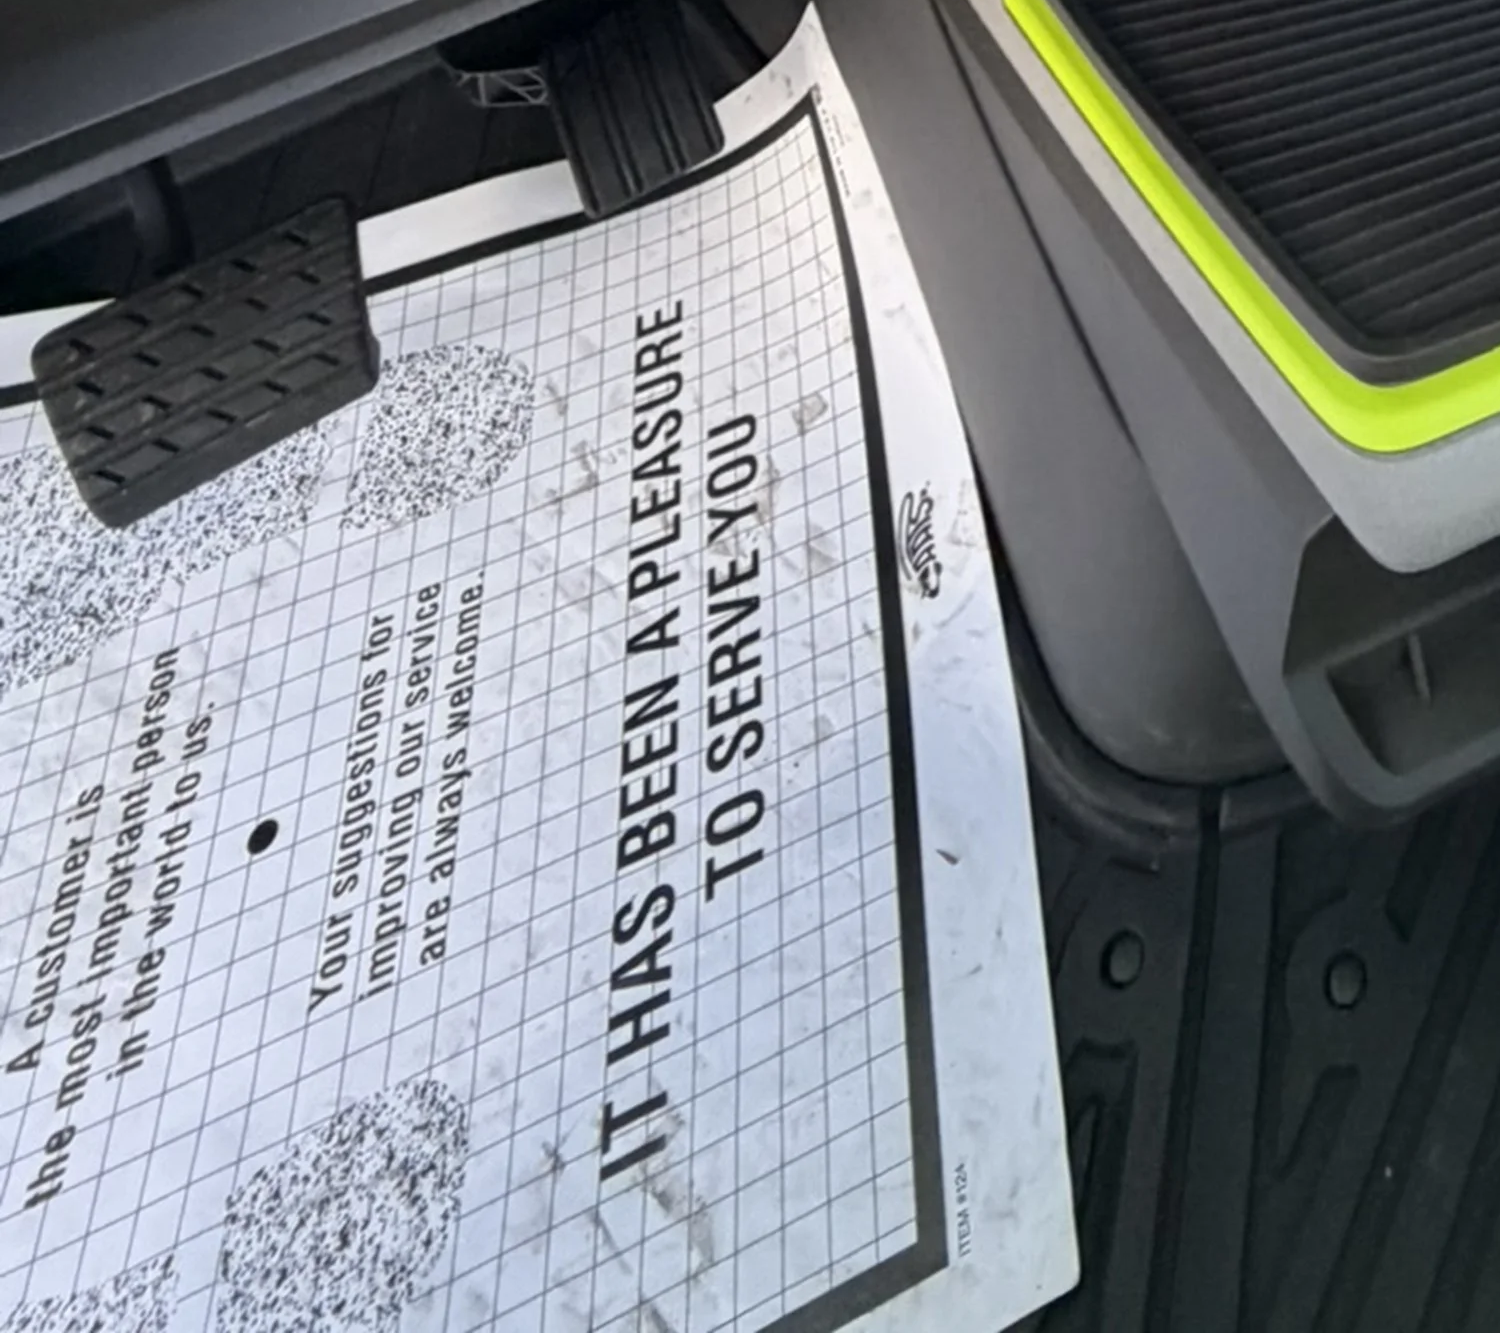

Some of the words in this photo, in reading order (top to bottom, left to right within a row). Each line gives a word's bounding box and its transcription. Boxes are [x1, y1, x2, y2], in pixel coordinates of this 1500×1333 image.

[629, 299, 684, 601] PLEASURE
[706, 413, 759, 545] YOU
[405, 581, 442, 709] service
[445, 569, 485, 741] welcome.
[626, 606, 680, 655] A
[706, 547, 764, 774] SERVE
[132, 646, 180, 774] person
[182, 701, 215, 762] us.
[396, 719, 426, 780] our
[66, 784, 105, 825] is
[166, 772, 202, 815] to
[307, 910, 353, 1014] Your
[332, 668, 388, 899] suggestions
[361, 612, 395, 664] for
[425, 746, 471, 886] always
[616, 674, 681, 871] BEEN
[77, 782, 153, 988] important
[145, 820, 192, 940] world
[358, 786, 423, 1002] improving
[705, 788, 765, 903] TO
[24, 833, 93, 1030] customer
[120, 946, 166, 1023] the
[419, 894, 451, 967] are
[607, 882, 677, 1067] HAS
[5, 1039, 45, 1074] A
[55, 993, 107, 1112] most
[105, 1030, 150, 1082] in
[24, 1124, 77, 1210] the
[599, 1090, 668, 1180] IT
[956, 1207, 972, 1258] ITEM
